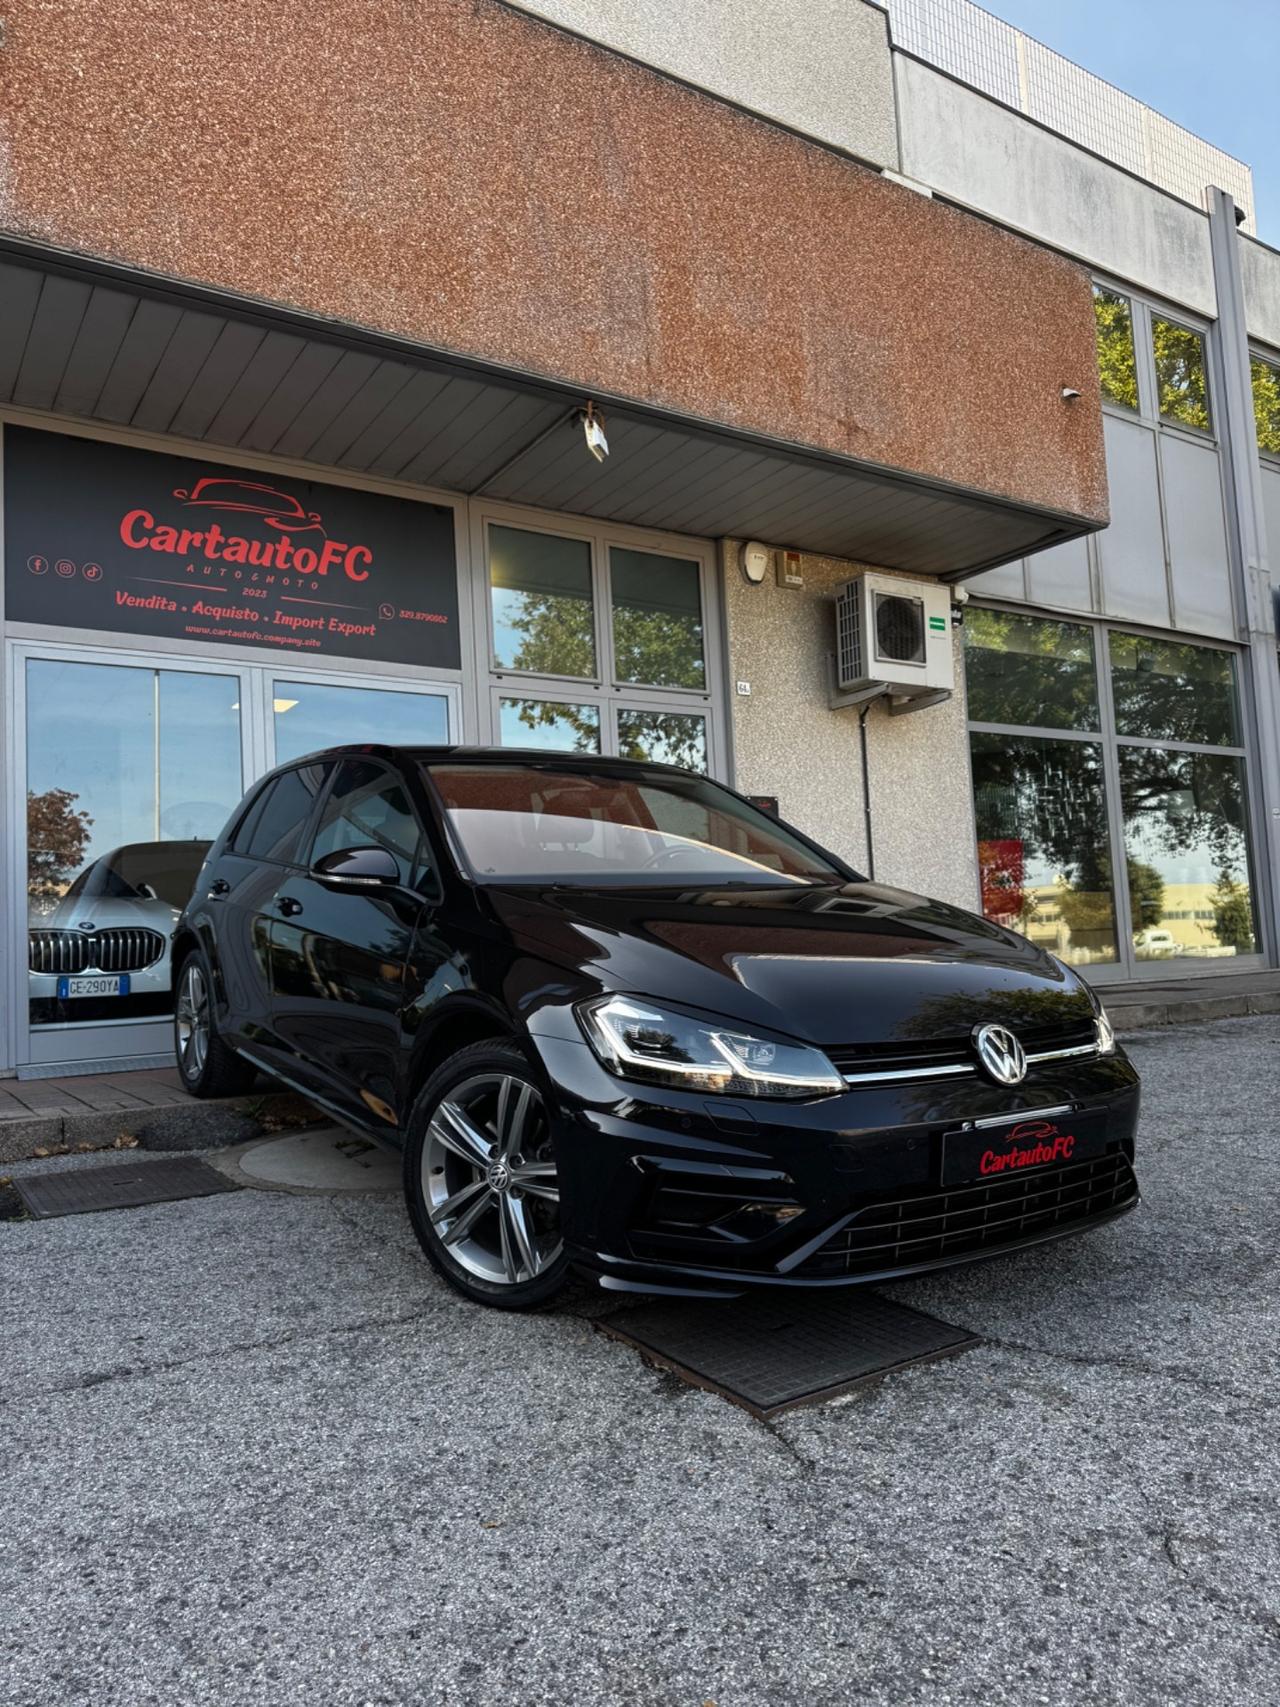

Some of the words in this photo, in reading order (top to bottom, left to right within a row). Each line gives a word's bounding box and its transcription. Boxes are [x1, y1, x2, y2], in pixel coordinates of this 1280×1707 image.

[119, 508, 373, 582] CartautoFC
[115, 591, 177, 611] Vendita
[192, 600, 259, 621] Acquisto
[273, 610, 326, 630] Import
[328, 617, 377, 636] Export
[242, 587, 268, 599] 2023
[980, 1135, 1075, 1174] CartautoFC
